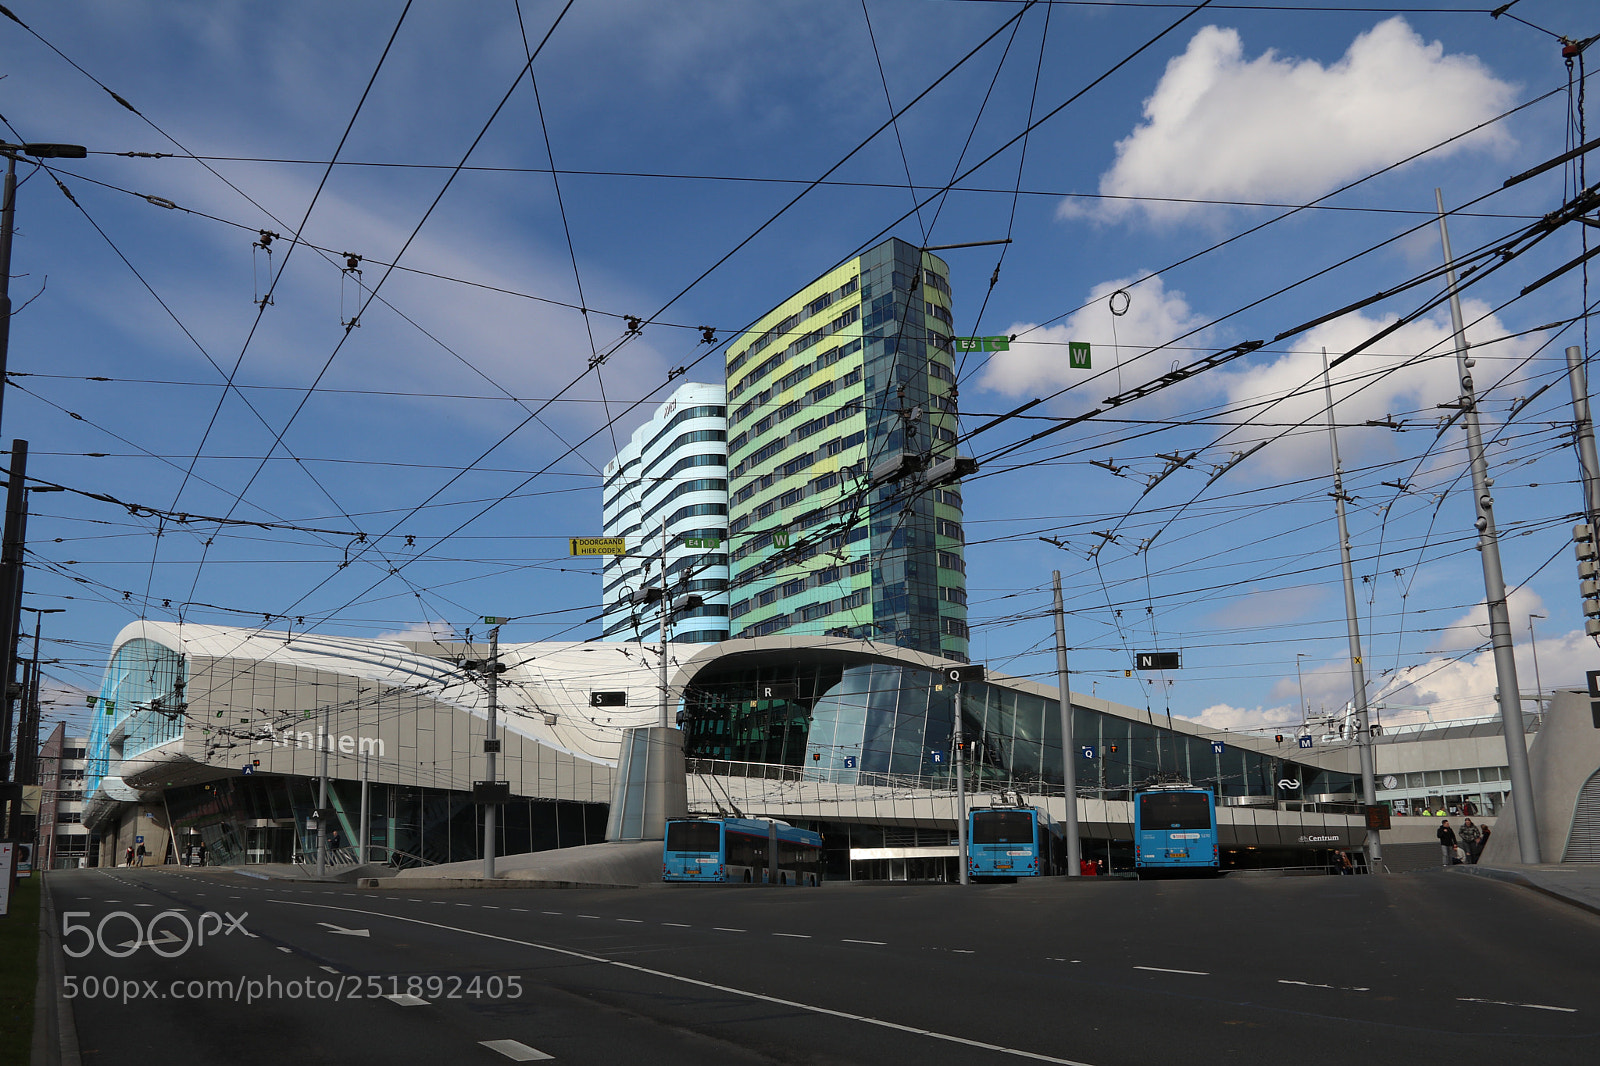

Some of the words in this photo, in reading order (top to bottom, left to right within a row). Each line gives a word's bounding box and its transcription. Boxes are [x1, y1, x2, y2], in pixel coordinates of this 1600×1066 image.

[962, 340, 976, 349] E3
[991, 338, 1001, 349] C
[1073, 349, 1087, 365] W
[708, 539, 715, 548] D
[775, 534, 787, 546] W
[1142, 656, 1152, 667] N
[949, 670, 960, 682] Q
[764, 687, 772, 697] R
[596, 694, 603, 704] S
[256, 722, 385, 757] Arnhem
[1301, 739, 1311, 748] M
[1214, 745, 1222, 753] N
[934, 754, 941, 762] R
[1085, 750, 1093, 759] Q
[847, 760, 853, 768] S
[312, 810, 319, 818] A
